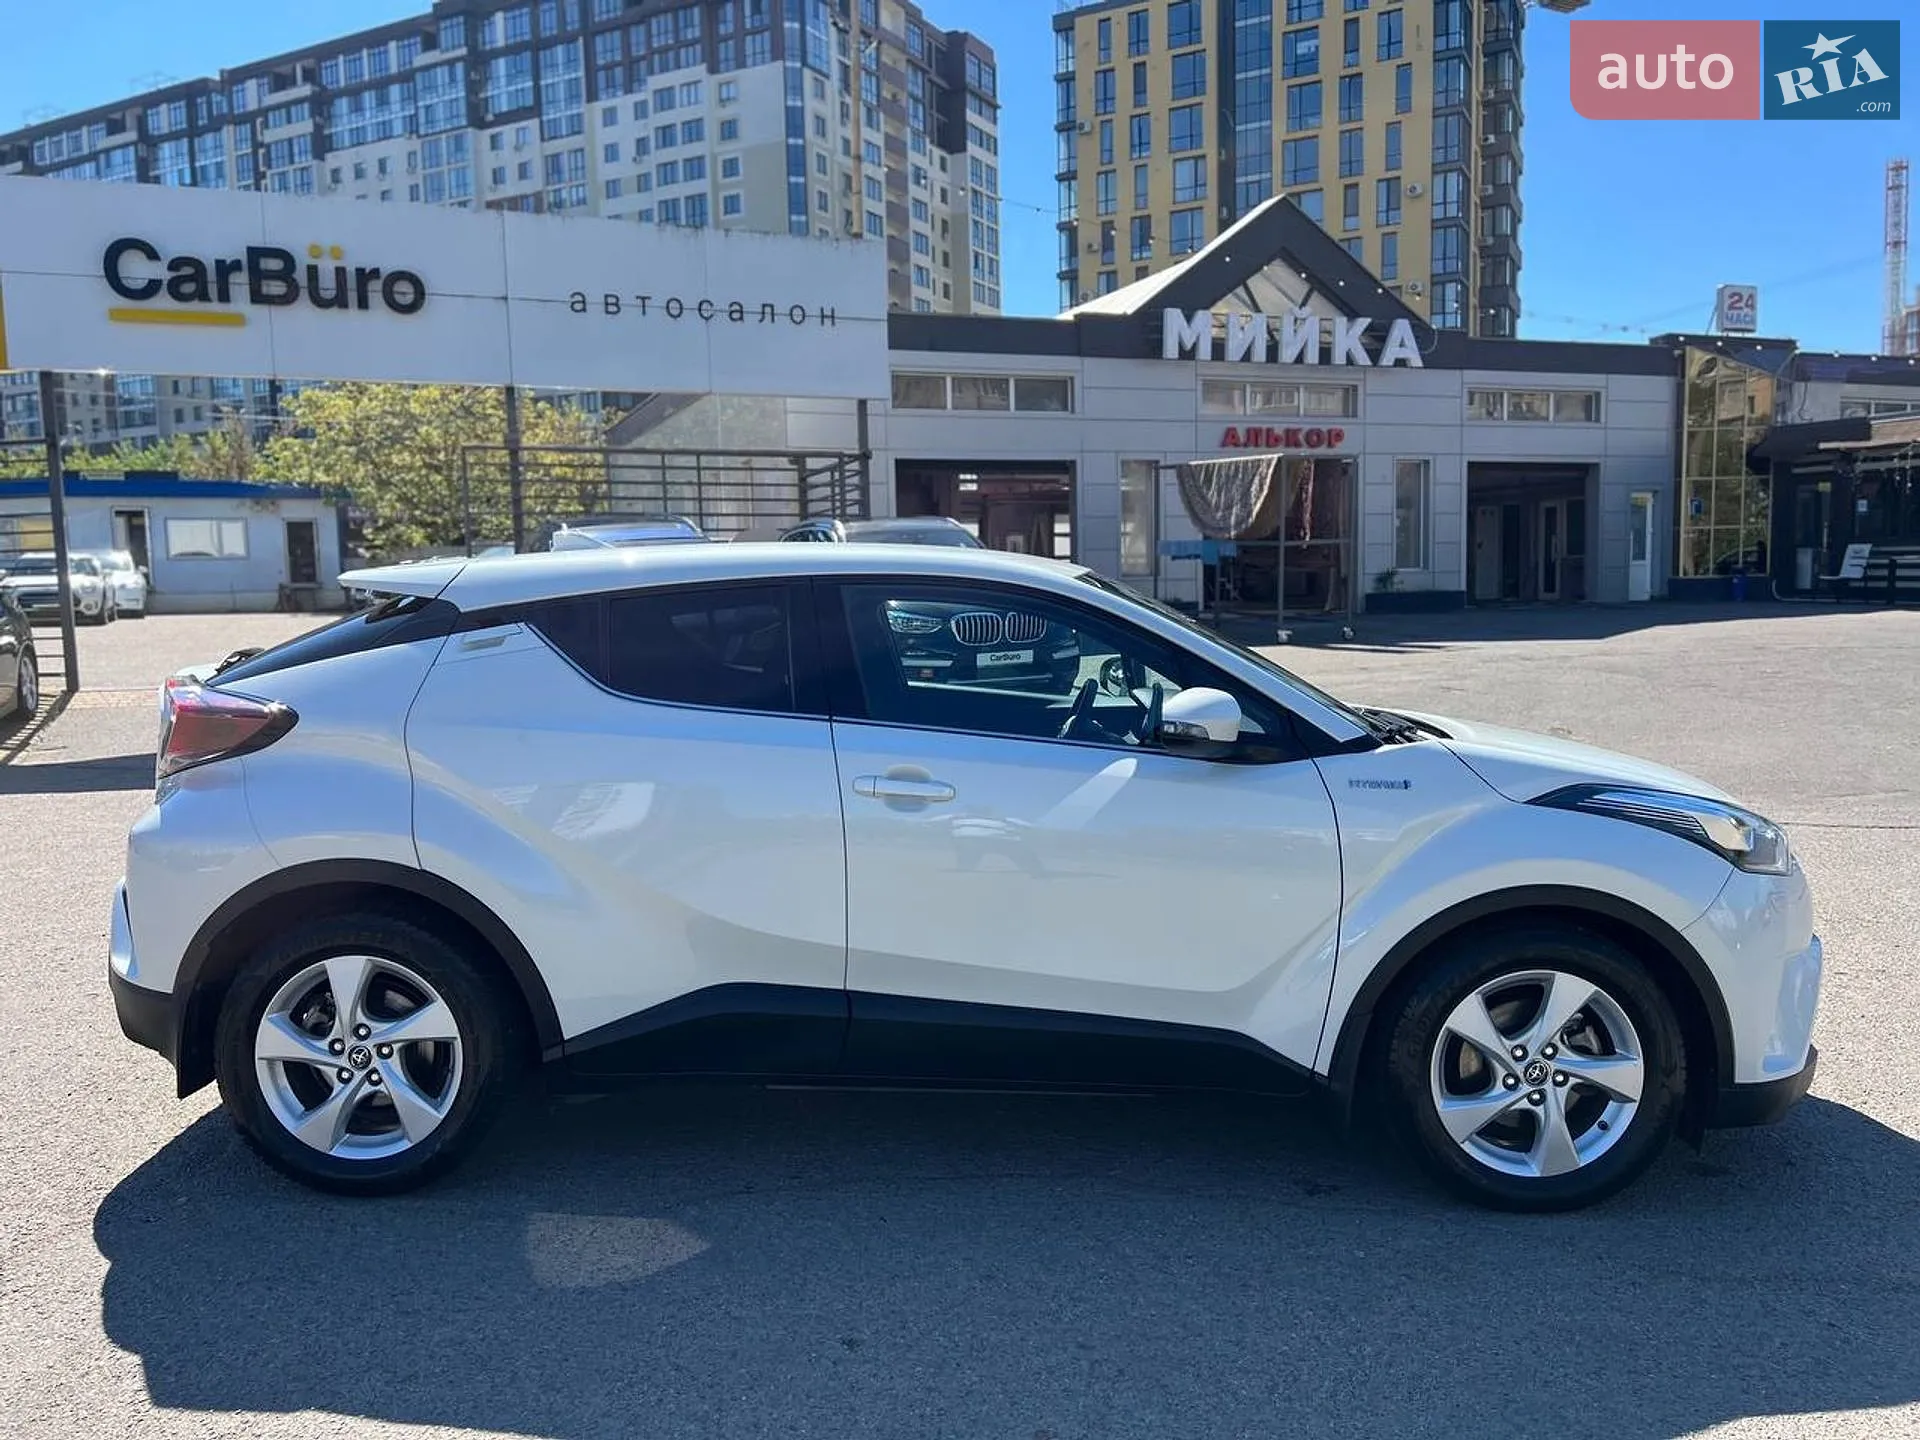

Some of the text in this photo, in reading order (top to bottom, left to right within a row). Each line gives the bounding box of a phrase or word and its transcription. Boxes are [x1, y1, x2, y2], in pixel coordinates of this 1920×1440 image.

[102, 236, 427, 315] CarBüro
[568, 291, 837, 327] автосалон
[1727, 291, 1755, 312] 24
[1162, 306, 1425, 368] МИЙКА
[1220, 426, 1345, 449] АЛЬКОР
